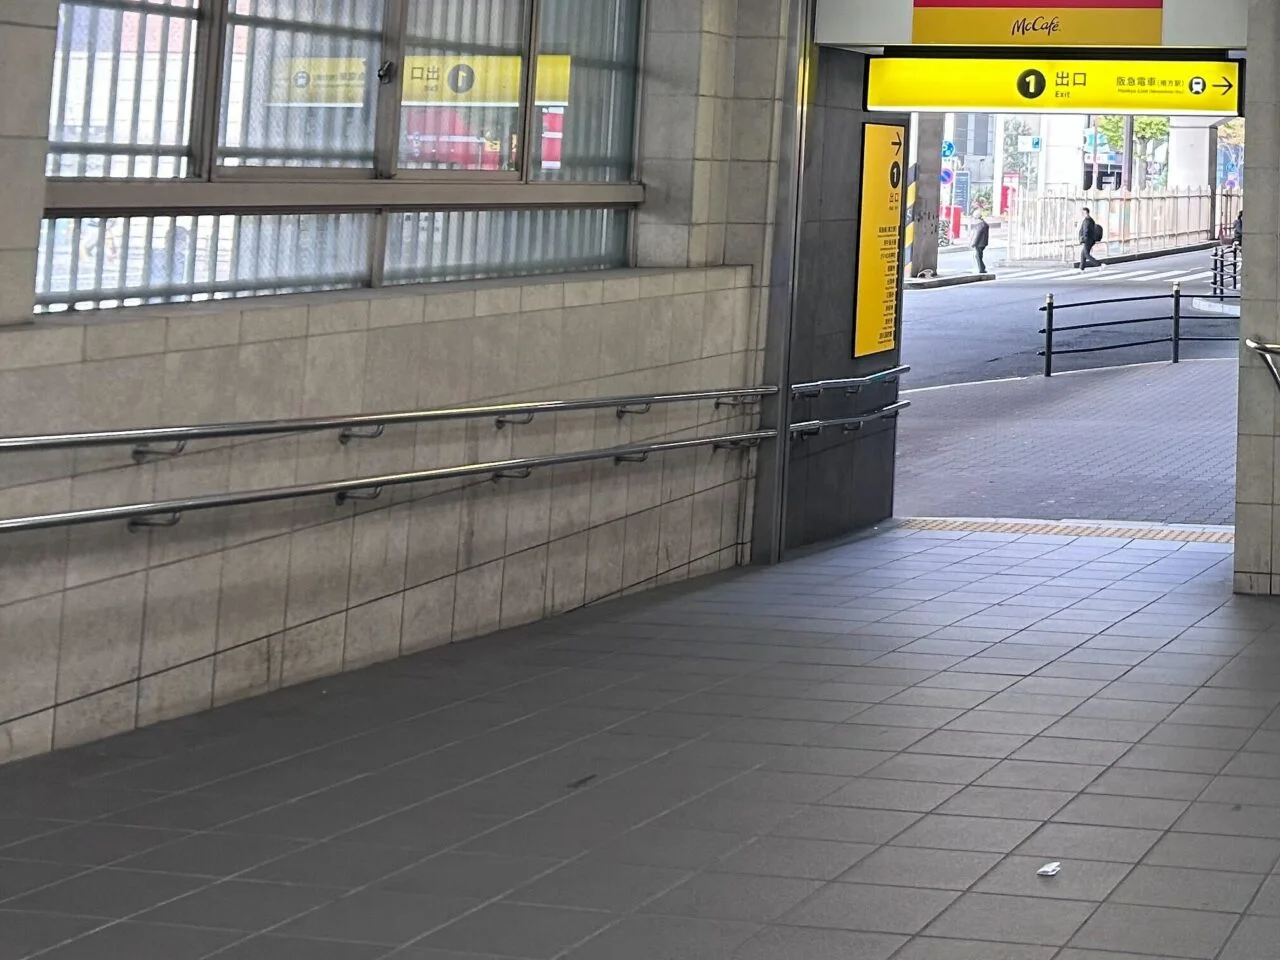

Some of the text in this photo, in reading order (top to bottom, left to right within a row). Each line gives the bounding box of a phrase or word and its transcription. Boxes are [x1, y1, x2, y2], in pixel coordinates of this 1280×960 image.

[1011, 15, 1060, 36] McCafé
[1025, 74, 1036, 93] 1
[1055, 71, 1087, 87] 出口
